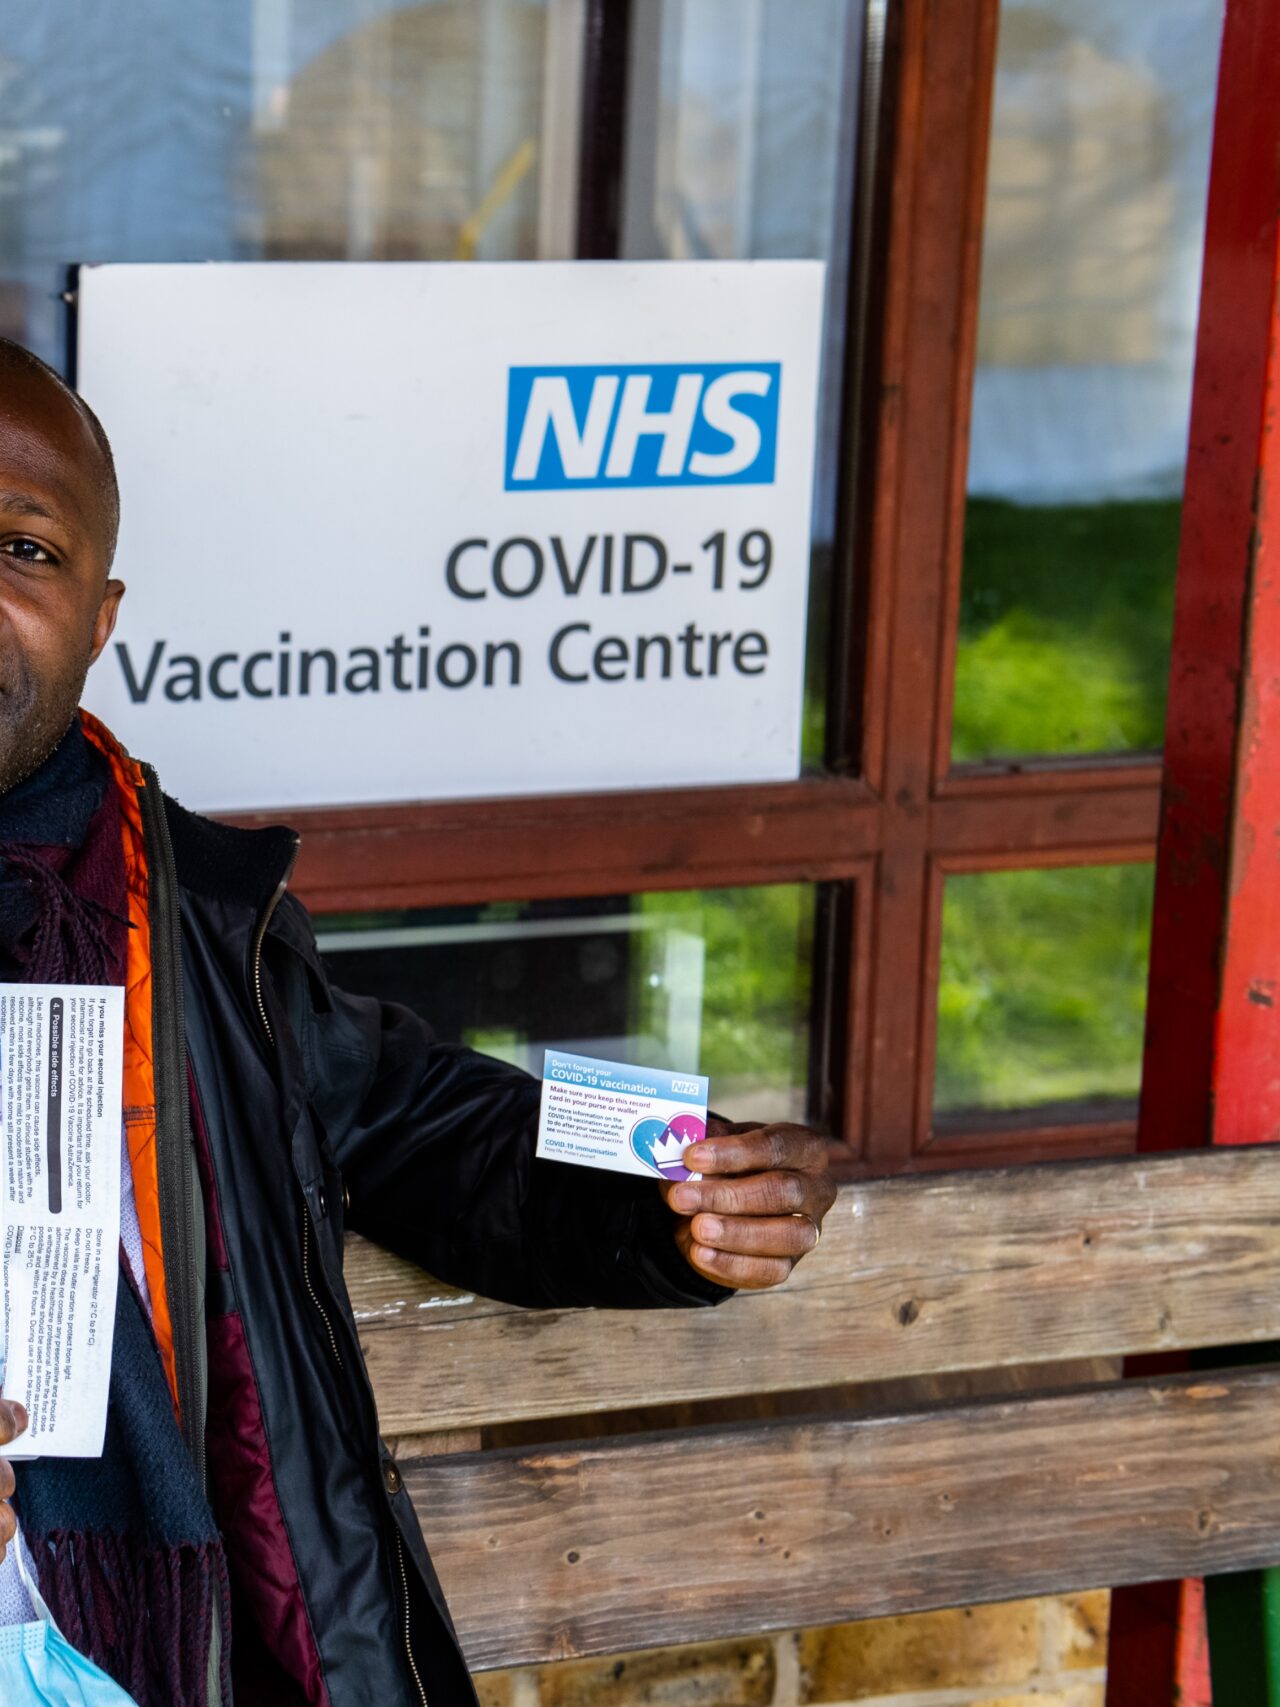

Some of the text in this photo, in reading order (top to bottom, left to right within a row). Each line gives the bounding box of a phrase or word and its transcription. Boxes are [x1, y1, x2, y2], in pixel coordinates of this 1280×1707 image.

[512, 371, 772, 480] NHS
[445, 529, 772, 601] COVID-19
[116, 621, 769, 704] Vaccination Centre
[552, 1069, 699, 1095] COVID-19 vaccination NHS
[573, 1063, 594, 1075] forget
[595, 1069, 612, 1078] your
[96, 1086, 104, 1117] injection
[550, 1086, 567, 1094] Make
[598, 1094, 614, 1104] keep
[629, 1100, 650, 1109] record
[573, 1099, 586, 1108] your
[589, 1102, 606, 1111] purse
[617, 1106, 638, 1115] wallet
